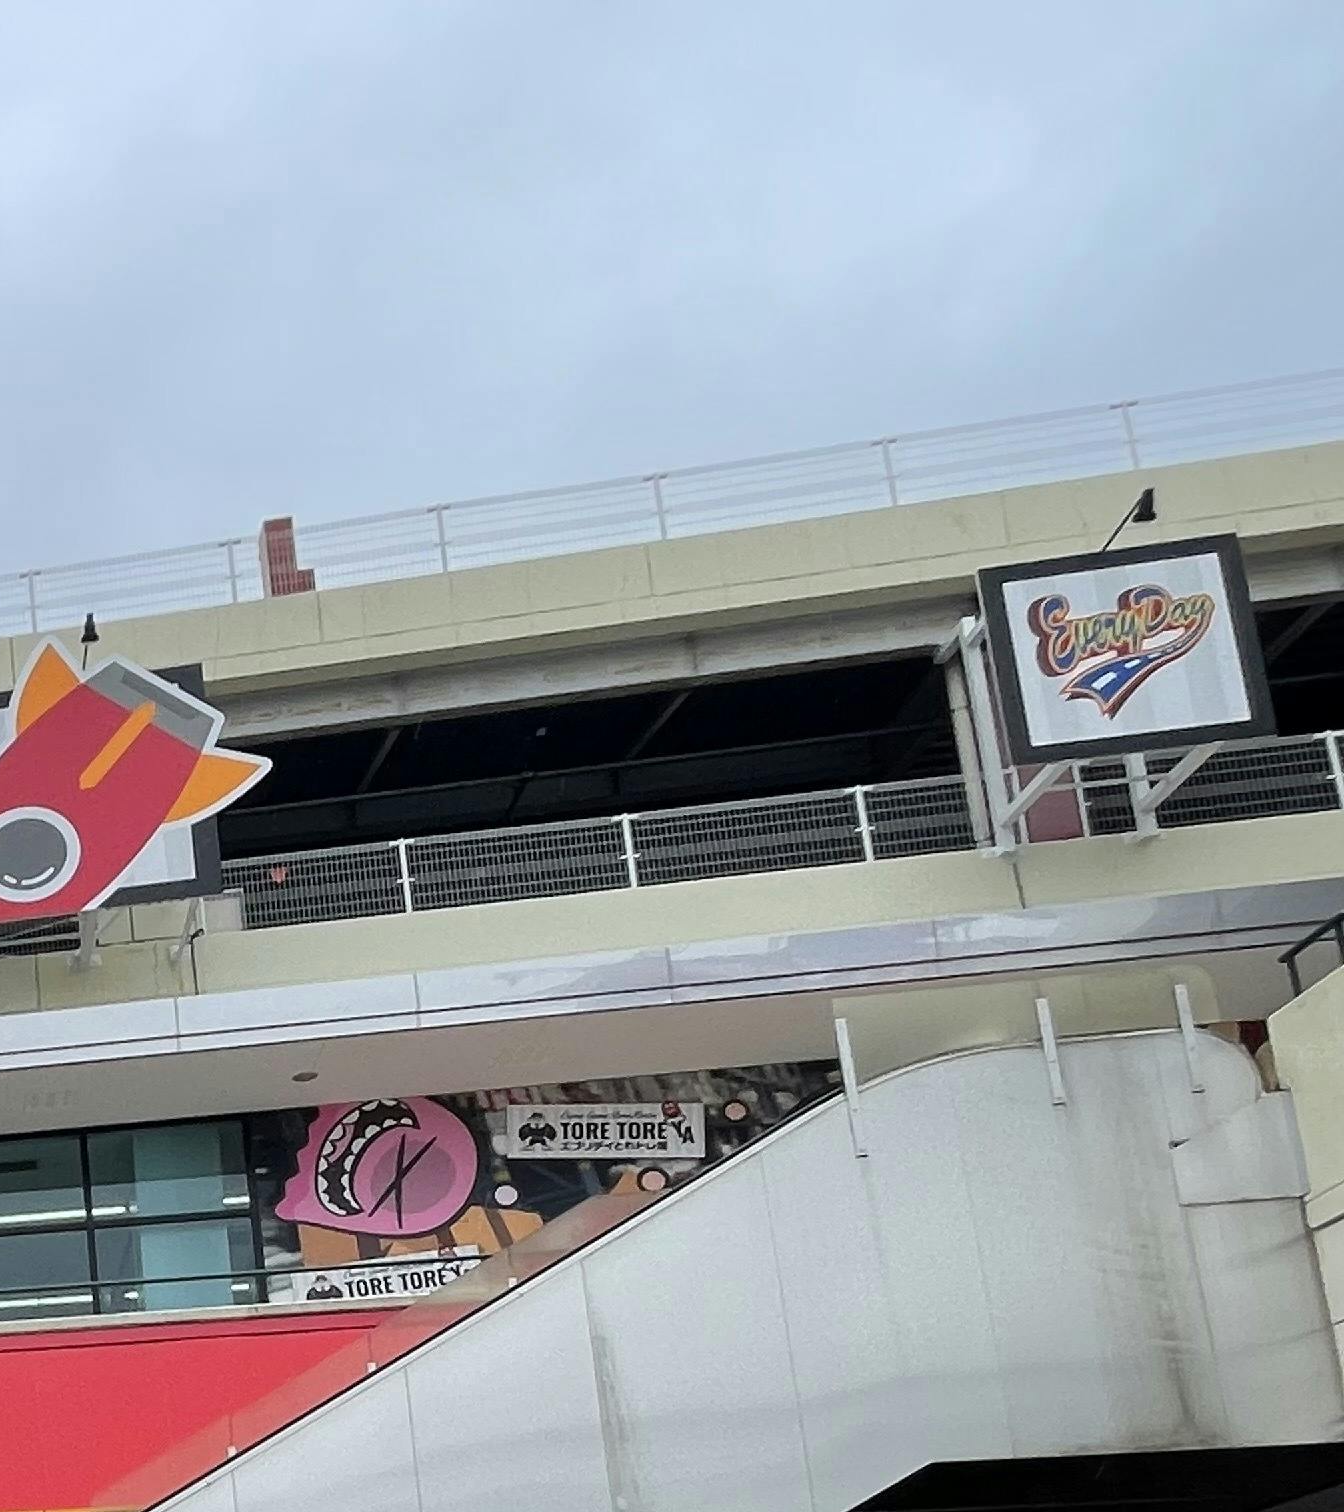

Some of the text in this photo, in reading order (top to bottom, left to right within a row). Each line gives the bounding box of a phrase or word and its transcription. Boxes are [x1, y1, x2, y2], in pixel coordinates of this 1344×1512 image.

[560, 1121, 610, 1140] TORE
[616, 1121, 668, 1140] TORE
[344, 1274, 395, 1297] TORE
[397, 1268, 448, 1291] TORE
